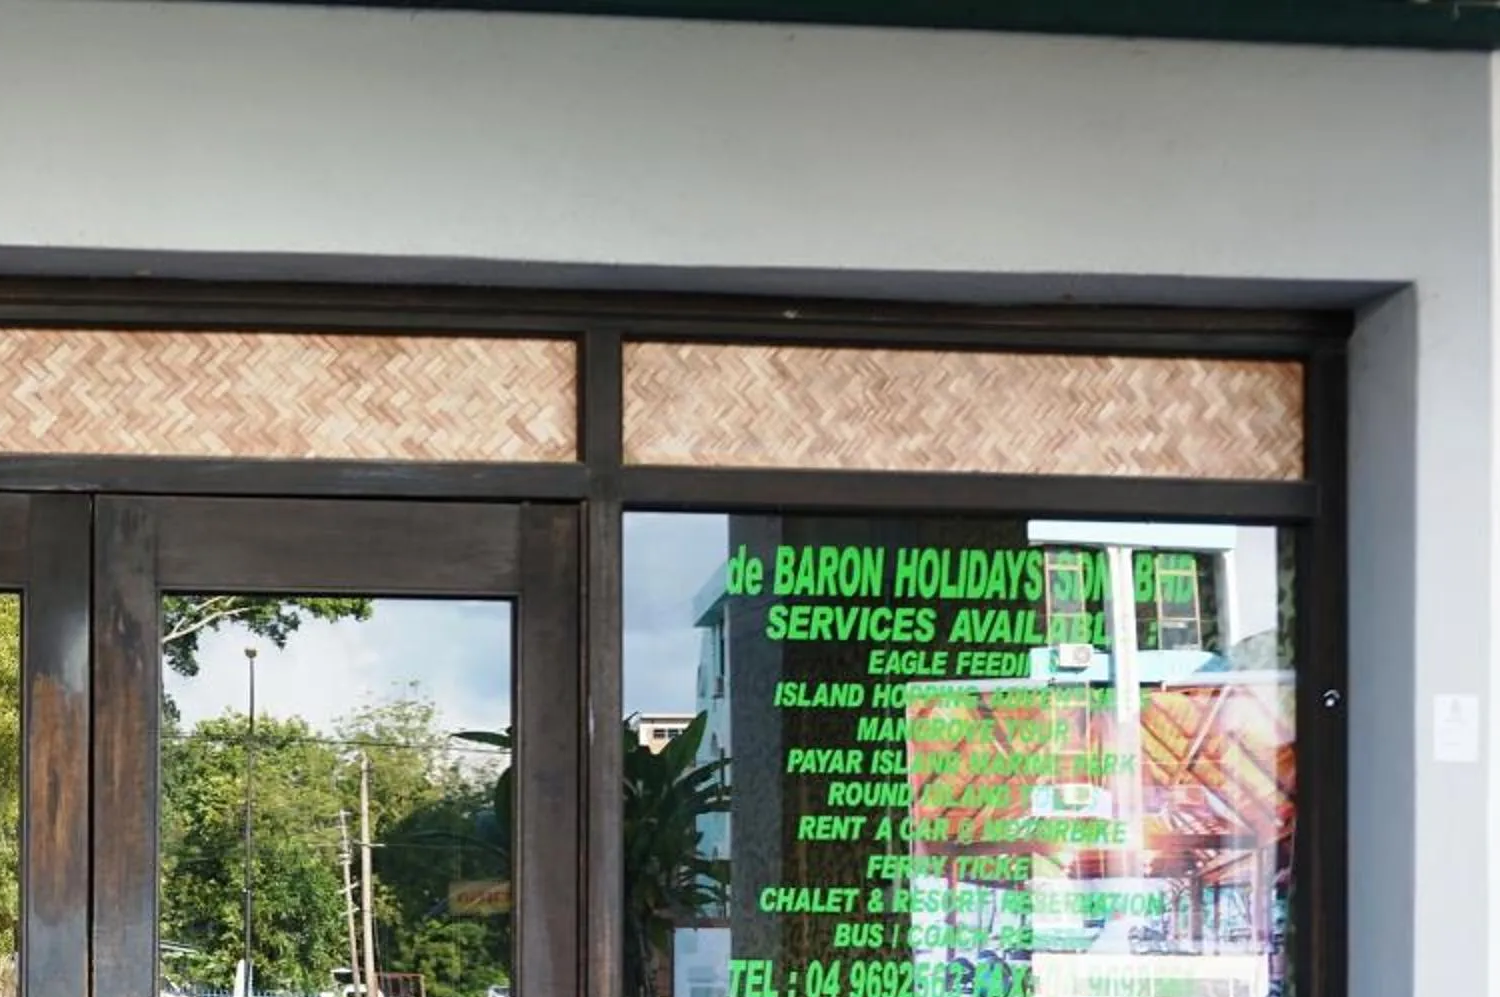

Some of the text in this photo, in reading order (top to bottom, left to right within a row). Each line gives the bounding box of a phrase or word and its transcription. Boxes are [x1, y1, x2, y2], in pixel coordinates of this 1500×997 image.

[726, 545, 764, 595] de
[773, 545, 885, 596] BARON
[894, 547, 1045, 600] HOLIDAYS
[766, 605, 937, 642] SERVICES
[948, 607, 1118, 646] AVAILABL
[867, 648, 1060, 677] EAGLE FEEDI
[773, 682, 865, 707] ISLAND
[787, 749, 863, 774] PAYAR
[827, 781, 913, 807] ROUND
[798, 815, 867, 841] RENT
[875, 816, 894, 841] A
[759, 888, 859, 913] CHALET
[867, 888, 885, 913] &
[833, 923, 885, 949] BUS
